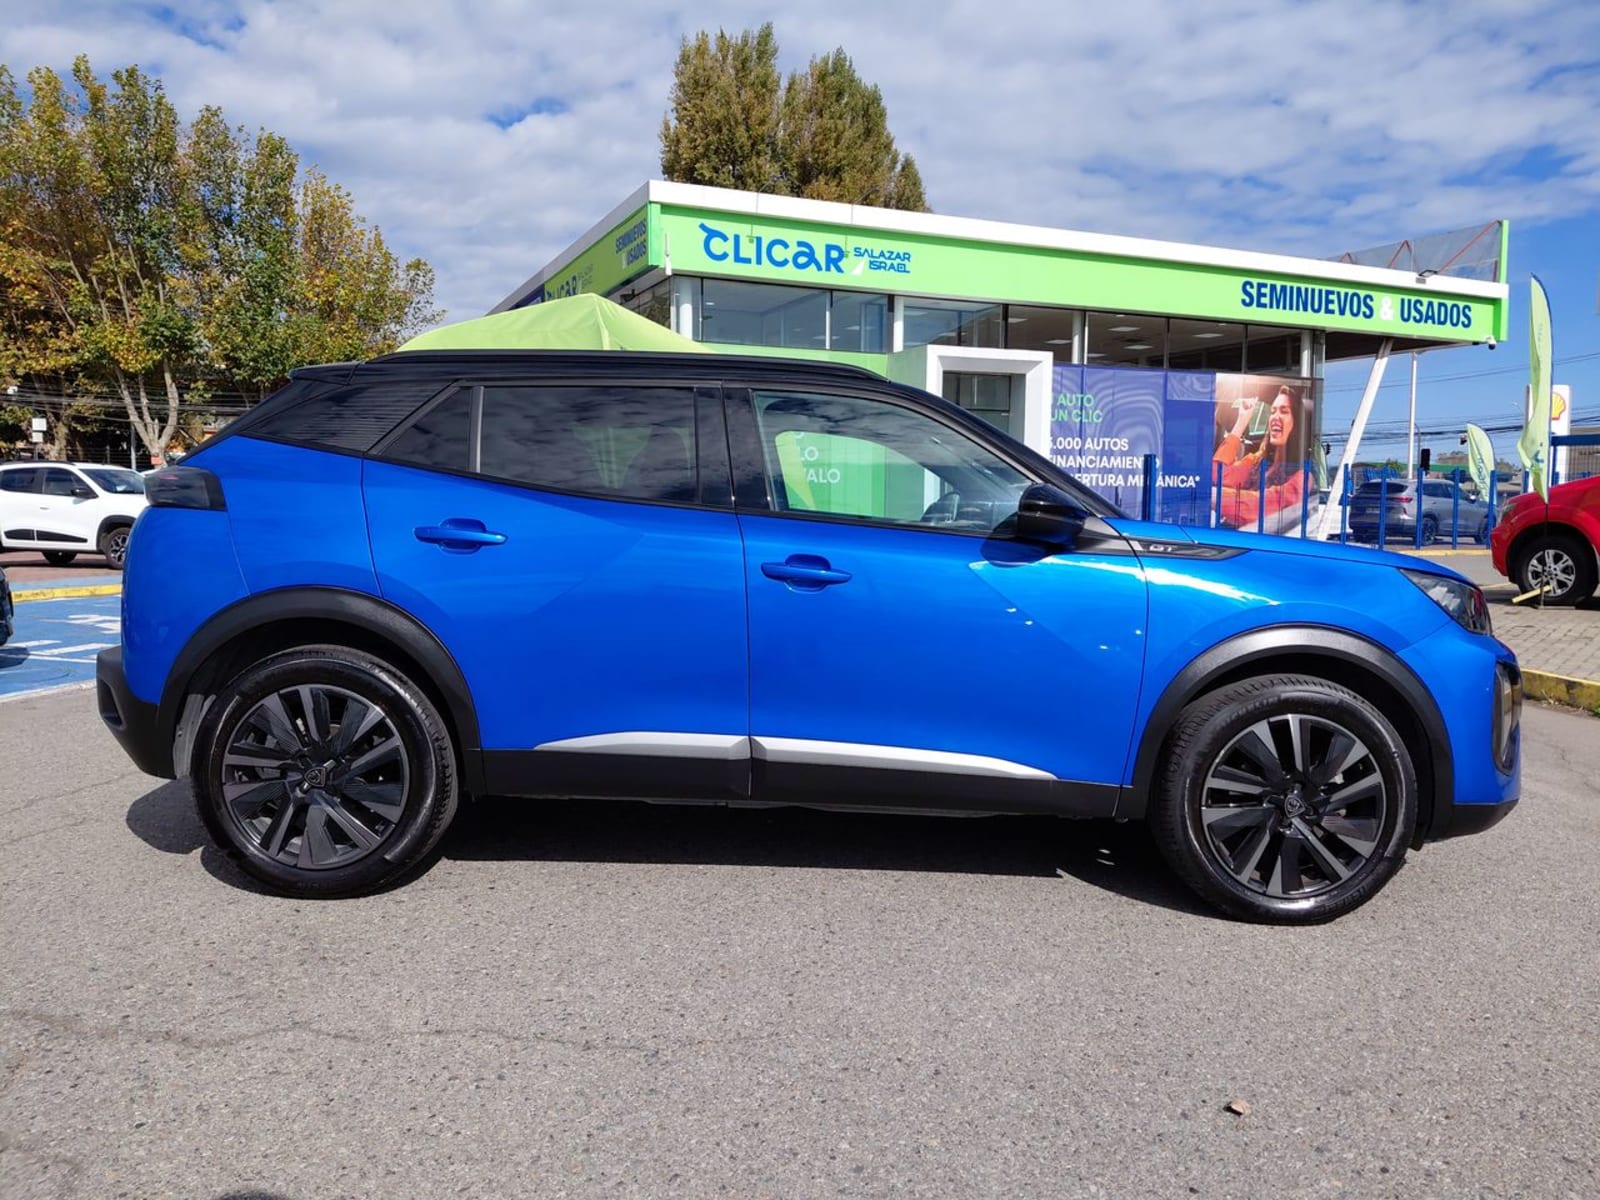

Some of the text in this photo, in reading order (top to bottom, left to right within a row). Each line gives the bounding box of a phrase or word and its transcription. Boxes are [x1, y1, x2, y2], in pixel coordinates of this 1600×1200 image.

[853, 246, 911, 263] SALAZAR
[868, 259, 911, 274] ISRAEL
[1241, 280, 1472, 329] SEMINUEVOS & USADOS
[1057, 394, 1095, 407] AUTO
[1072, 410, 1103, 423] CLIC
[1084, 437, 1129, 450] AUTOS
[1049, 455, 1160, 469] INANCIAMIEN
[1127, 472, 1200, 488] MÁNICA
[1149, 543, 1178, 552] GT
